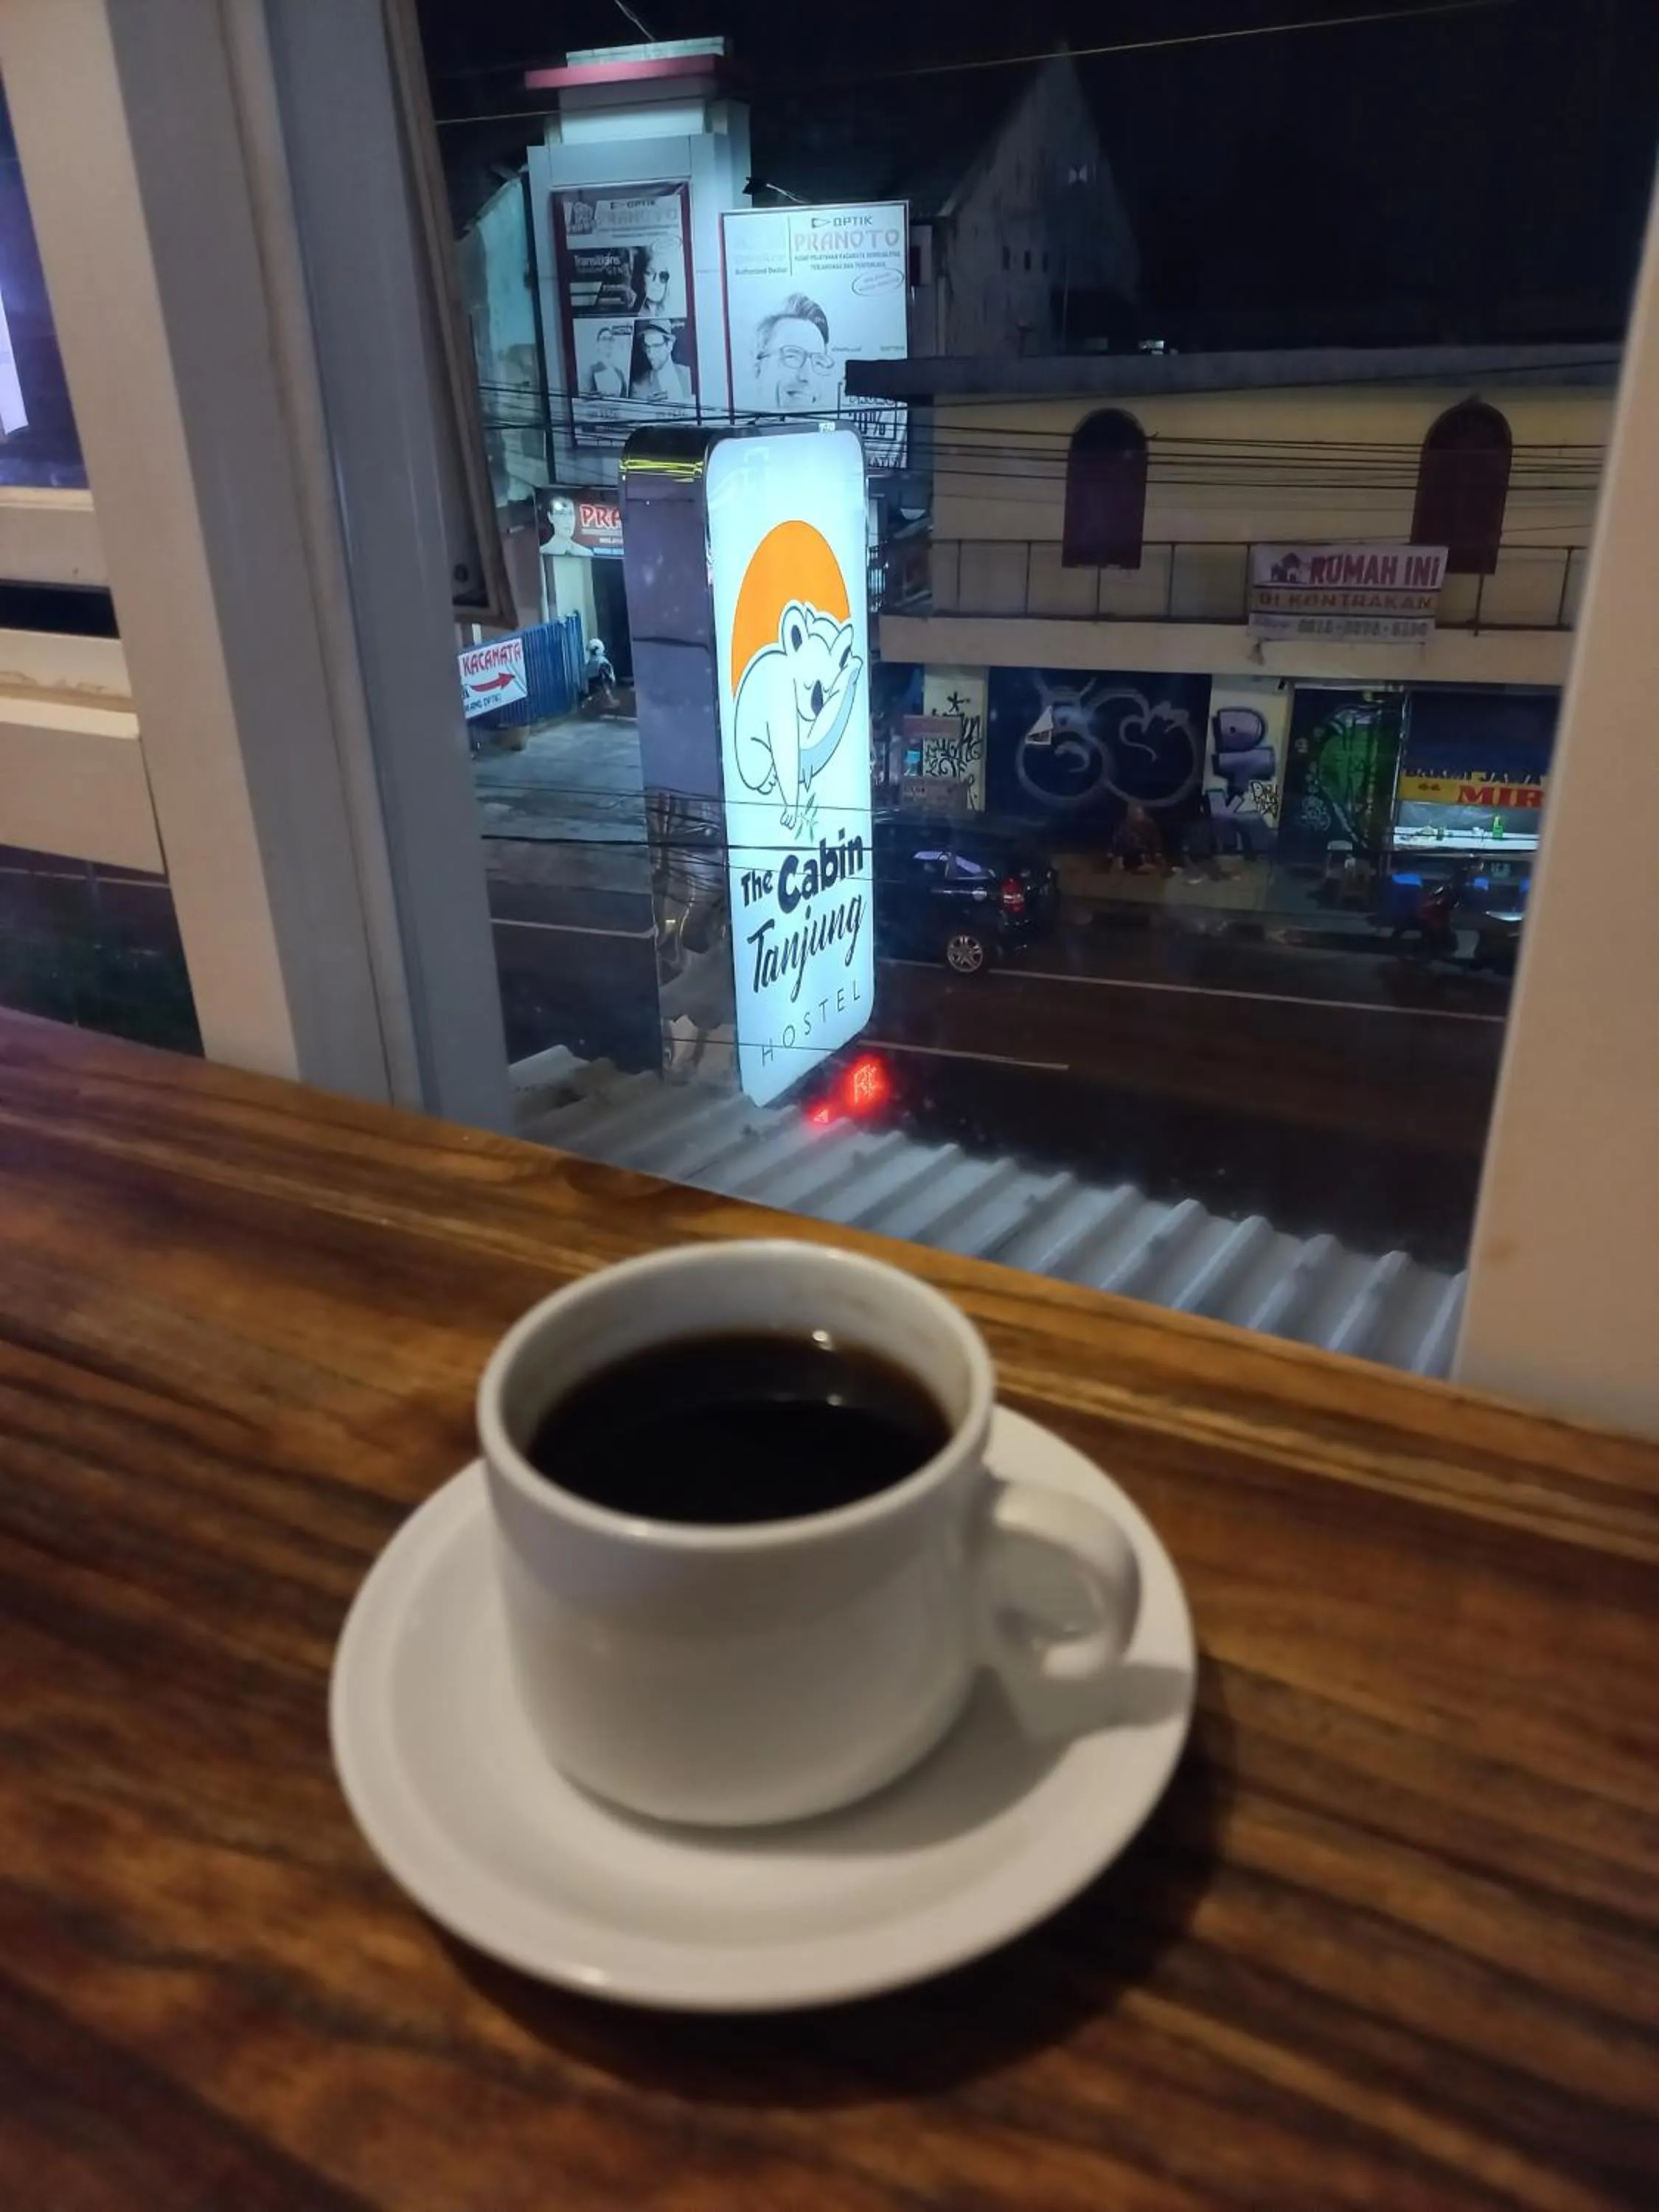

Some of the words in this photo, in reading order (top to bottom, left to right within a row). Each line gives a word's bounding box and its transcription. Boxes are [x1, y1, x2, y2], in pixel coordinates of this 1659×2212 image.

[833, 216, 873, 227] OPTIK
[794, 229, 900, 251] PRANOTO
[1309, 554, 1398, 585] RUMAH
[1405, 556, 1440, 586] INI
[1288, 593, 1432, 610] KONTRAKAN
[740, 869, 773, 908] The
[778, 828, 863, 914] Cabin
[747, 894, 866, 1003] Tanjung
[762, 978, 860, 1066] HOSTEL
